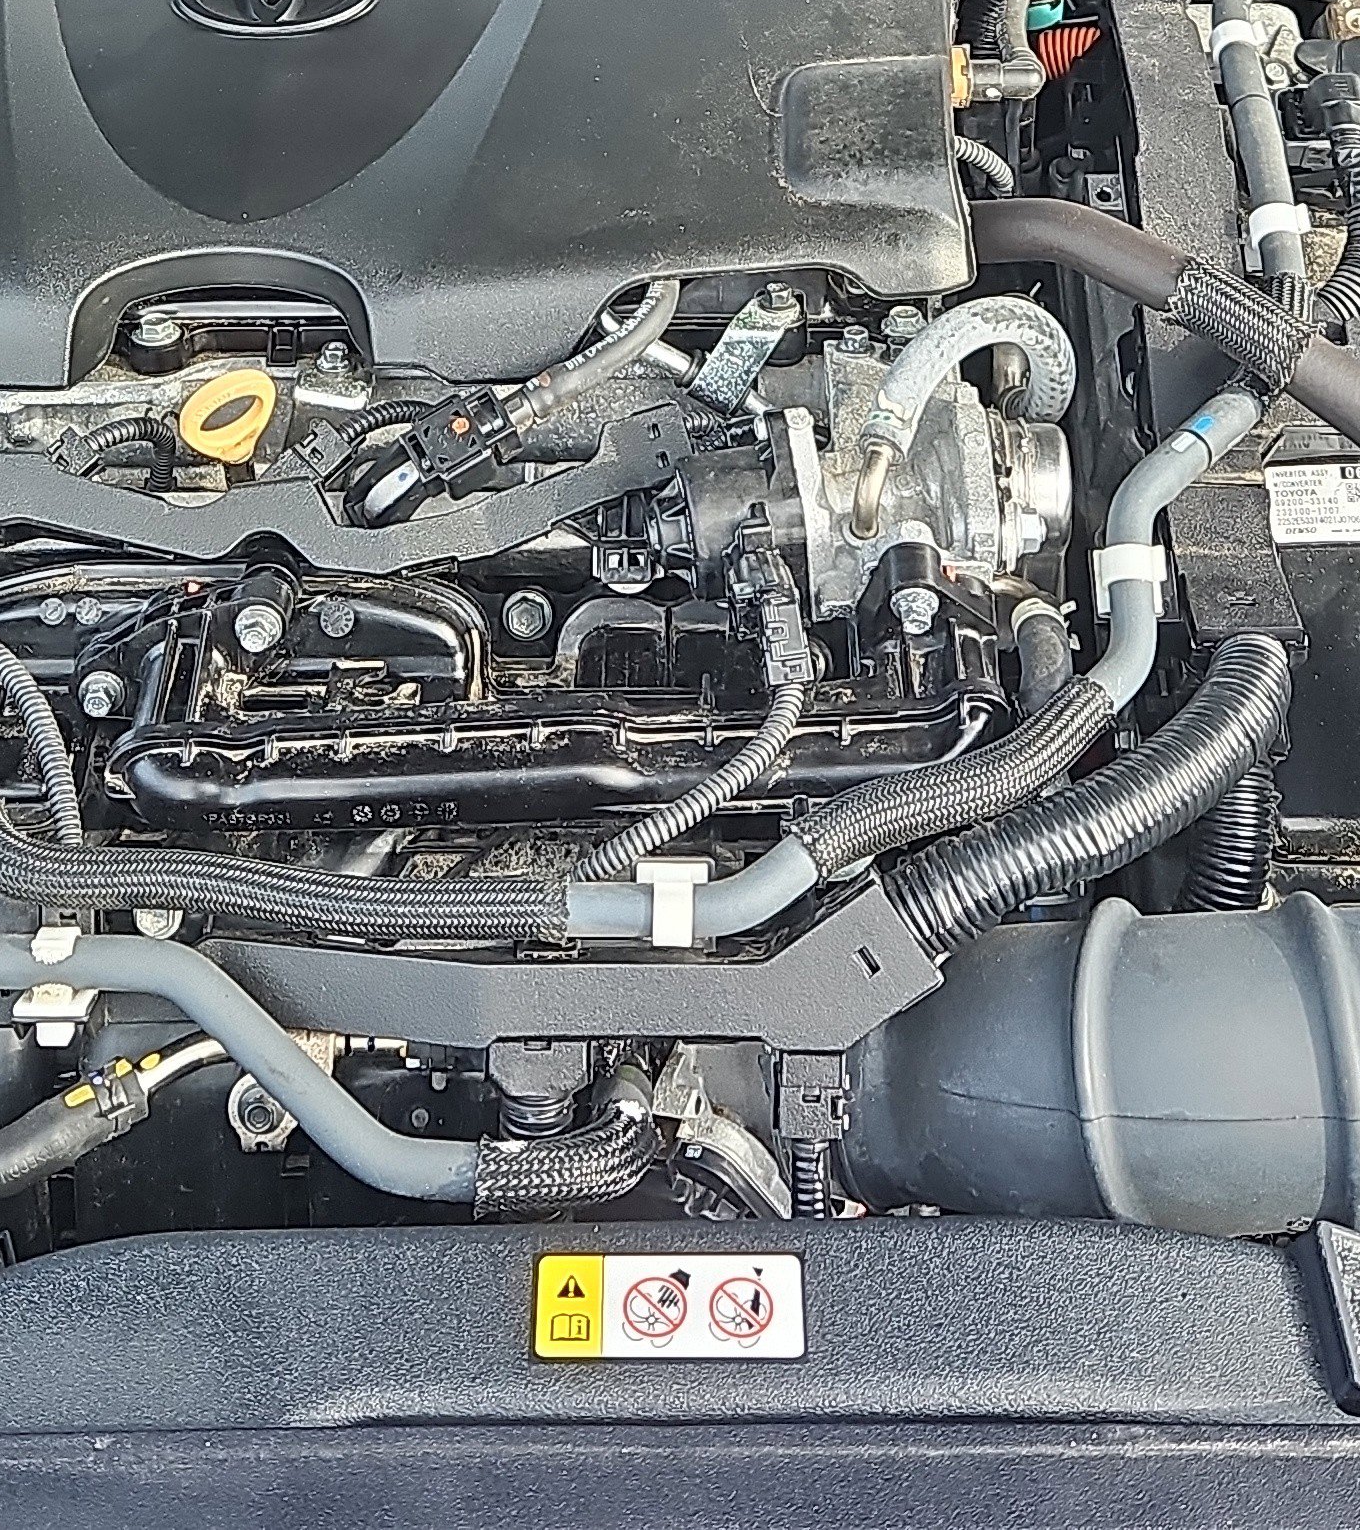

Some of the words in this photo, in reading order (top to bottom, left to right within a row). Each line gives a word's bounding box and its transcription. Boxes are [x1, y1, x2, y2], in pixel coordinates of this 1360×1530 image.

[1272, 469, 1307, 478] INVERTER
[1274, 489, 1318, 498] TOYOTA
[1285, 527, 1317, 535] DENSO
